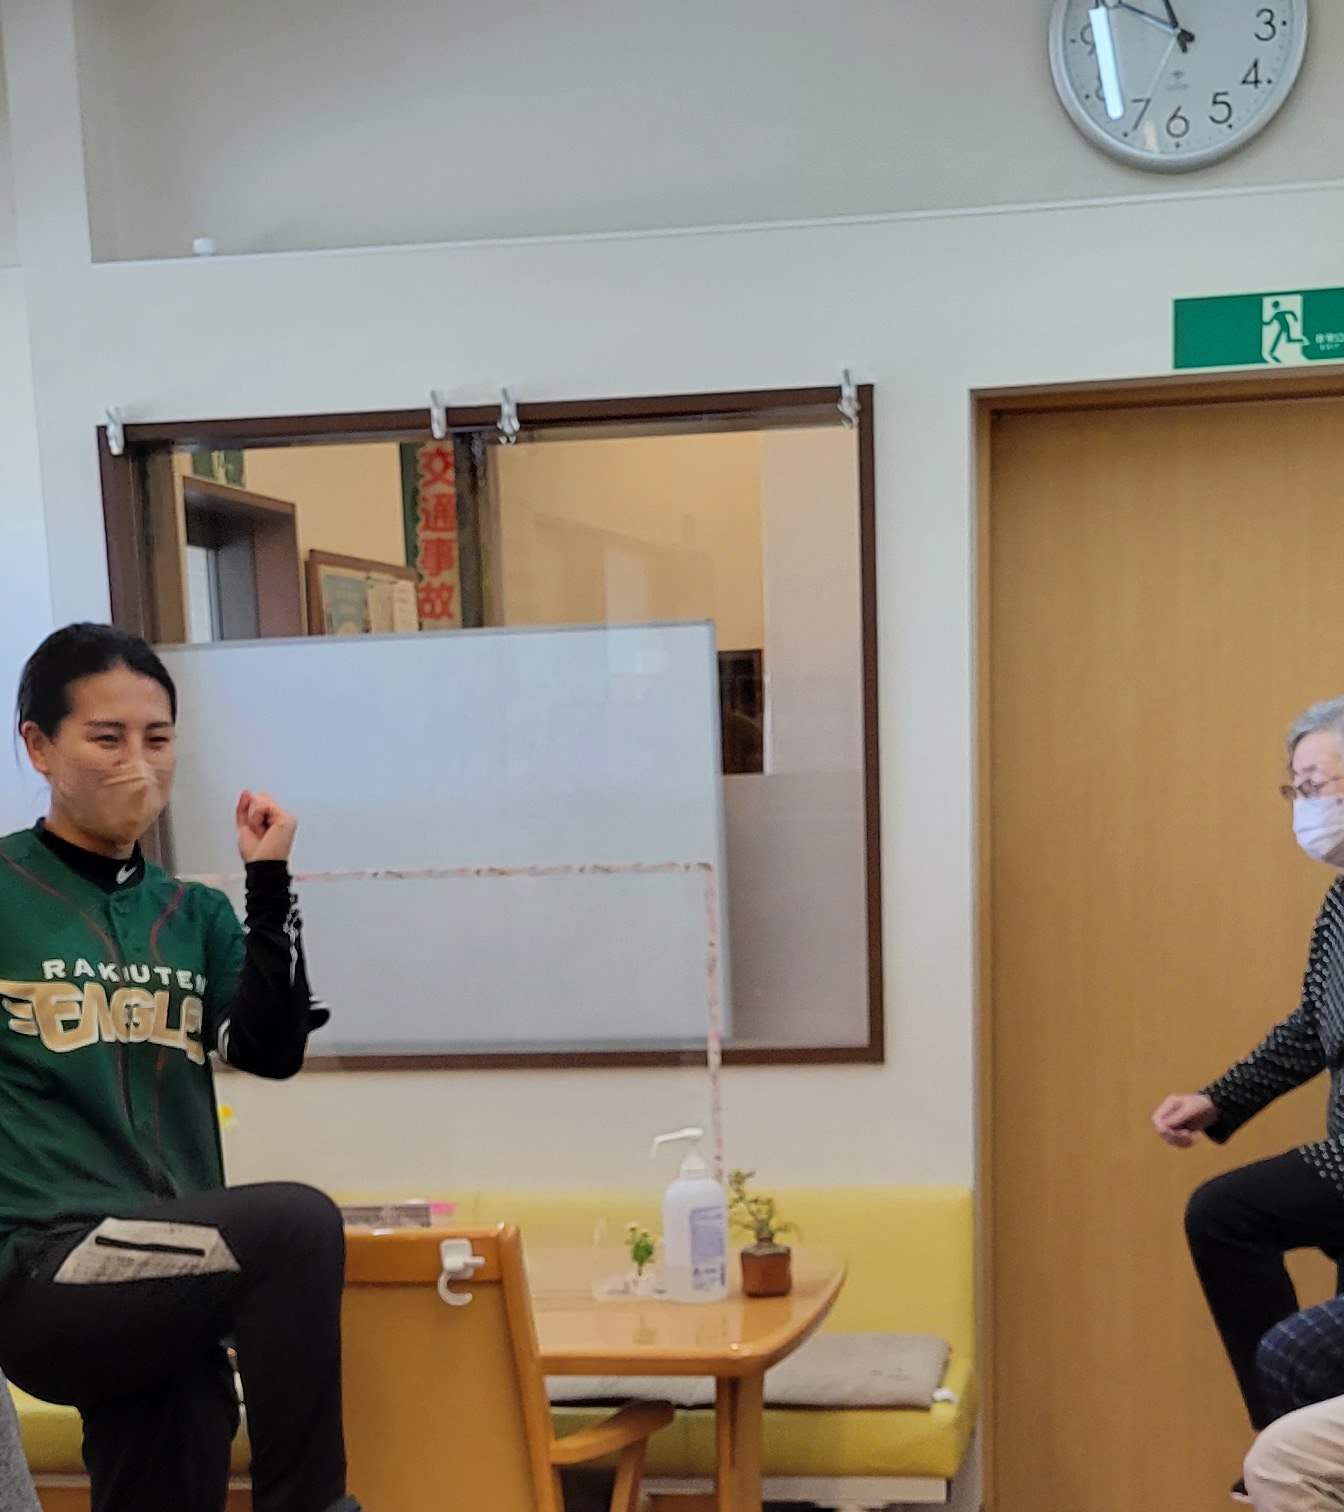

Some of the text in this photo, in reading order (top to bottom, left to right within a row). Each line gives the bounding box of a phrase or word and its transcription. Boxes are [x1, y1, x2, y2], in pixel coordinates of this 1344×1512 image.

[1254, 9, 1276, 42] 3
[1241, 58, 1262, 89] 4
[1132, 98, 1152, 132] 7
[1166, 106, 1189, 138] 6
[1209, 92, 1232, 125] 5
[418, 447, 455, 620] 交通事故
